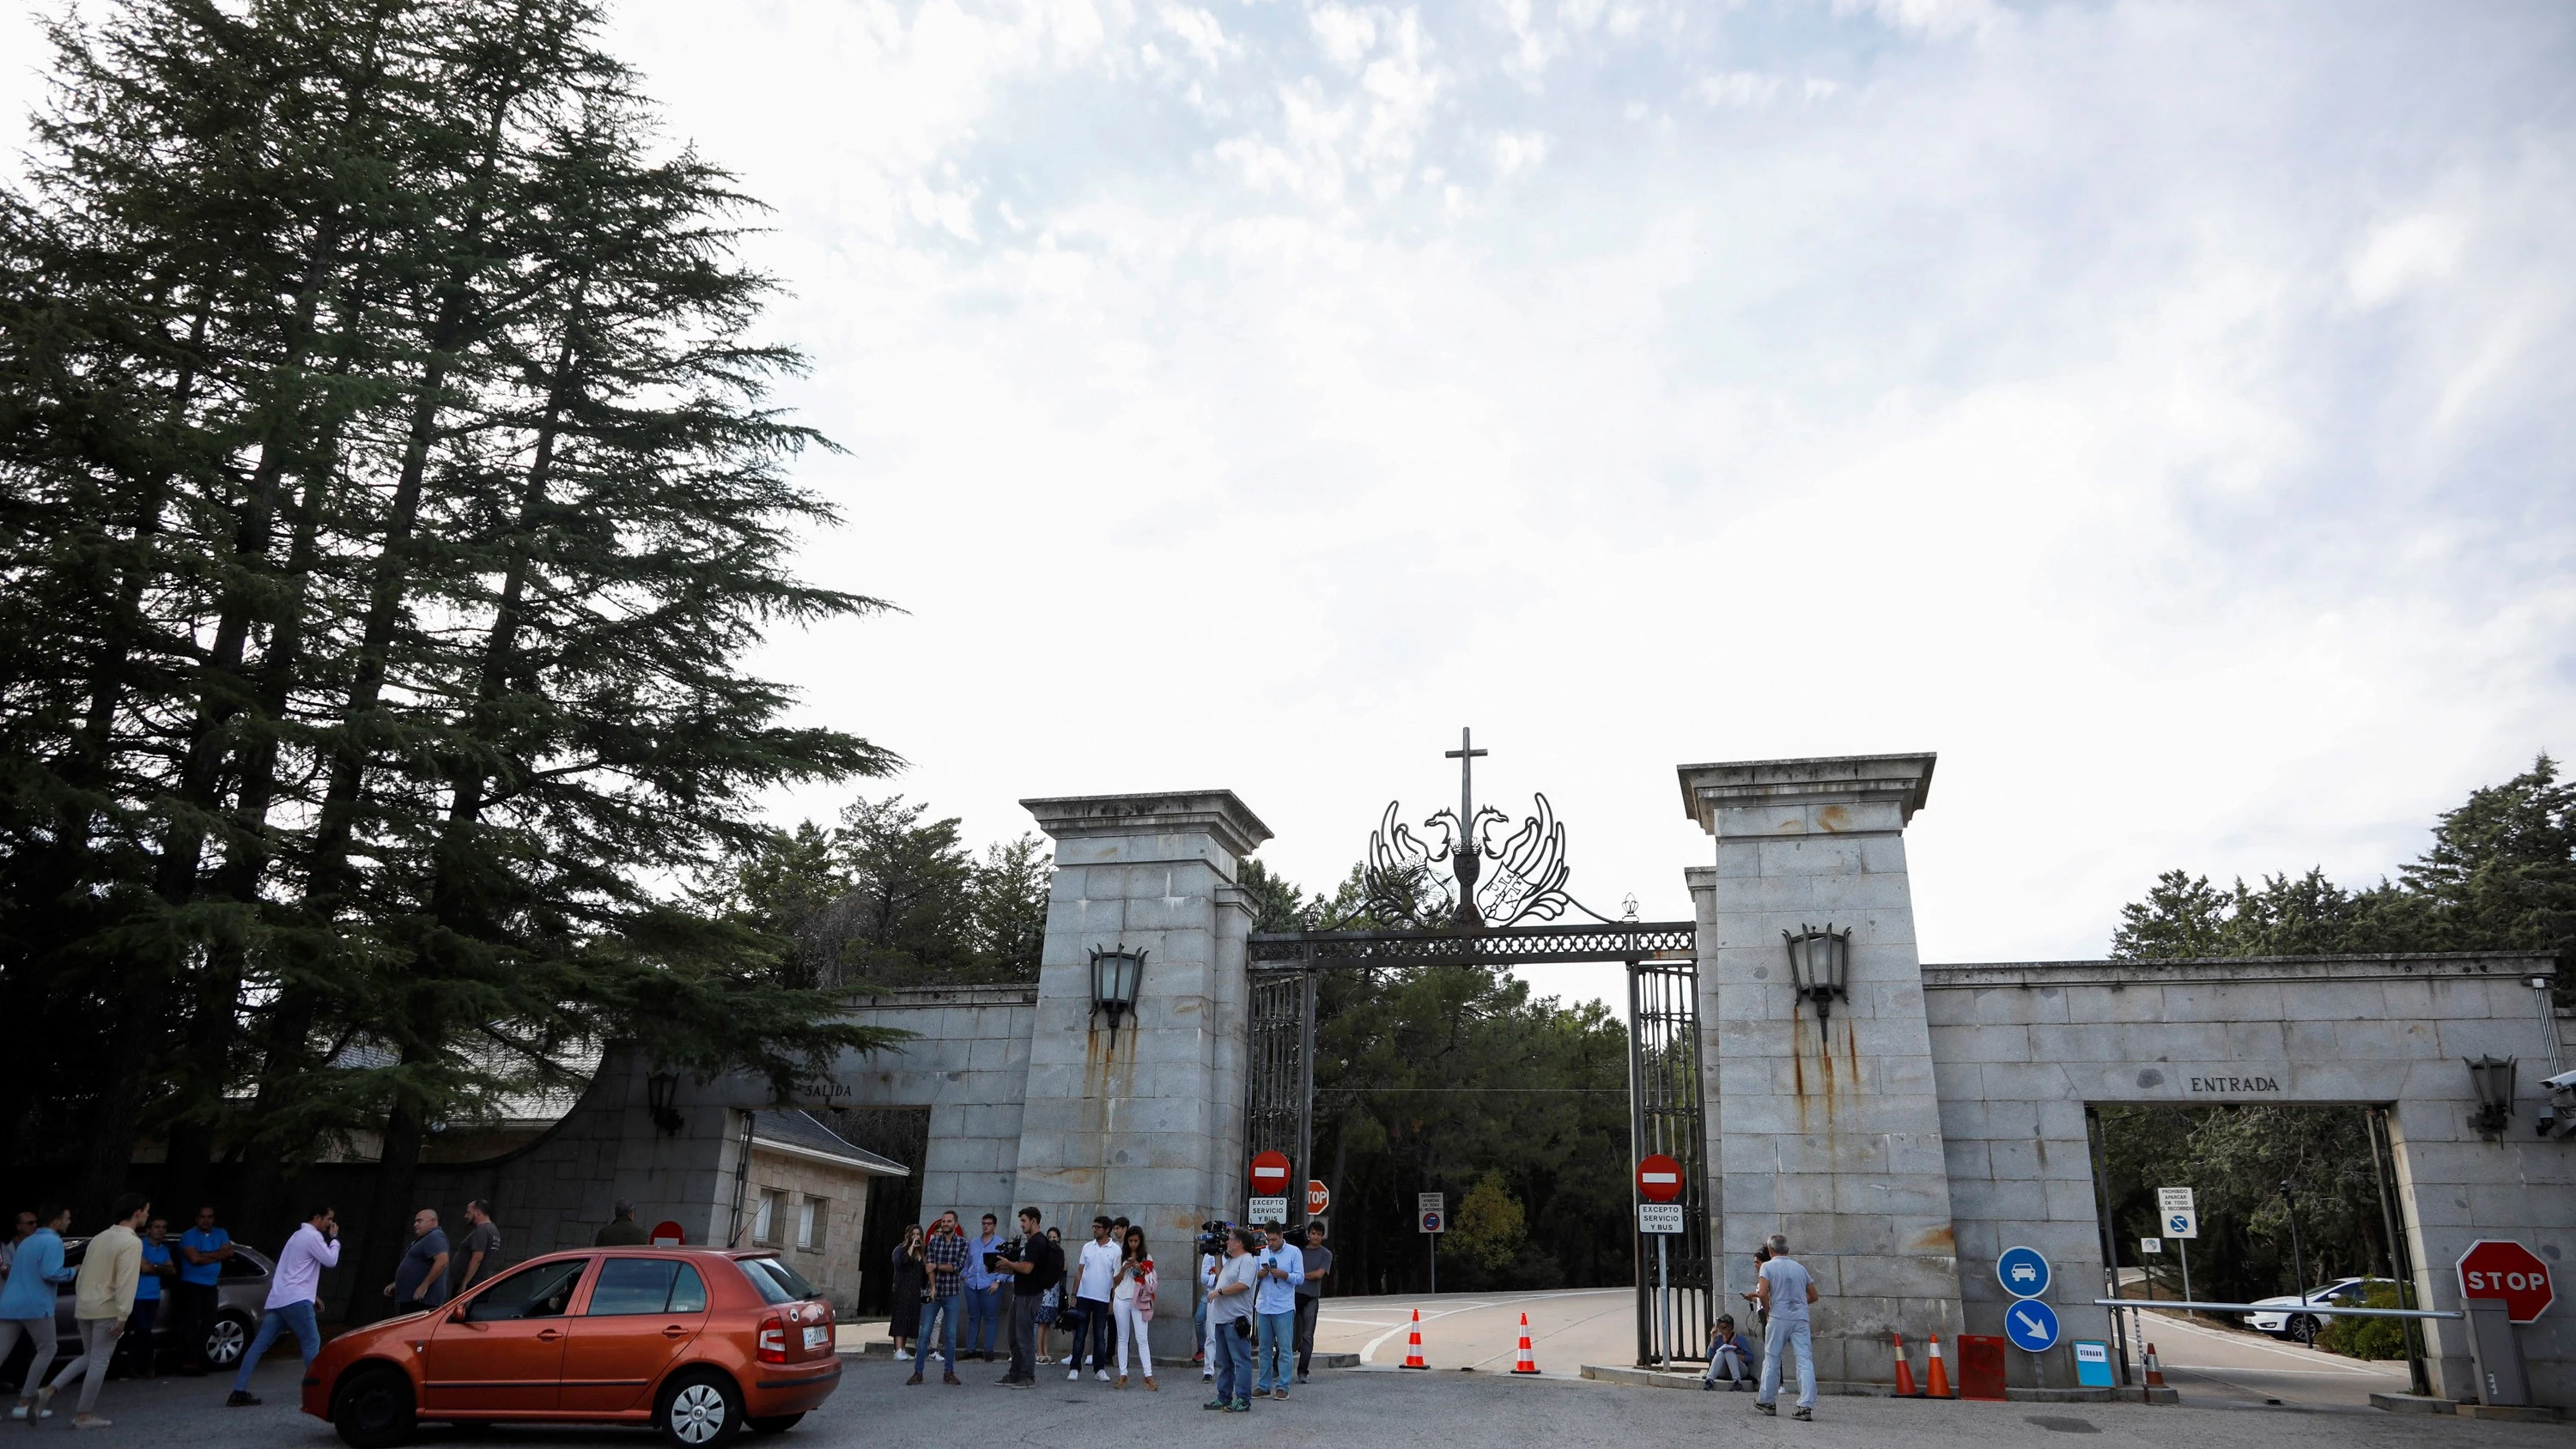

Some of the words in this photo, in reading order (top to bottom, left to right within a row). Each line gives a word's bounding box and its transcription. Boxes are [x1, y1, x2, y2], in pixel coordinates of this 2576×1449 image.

[805, 1084, 852, 1097] SALIDA
[2190, 1077, 2280, 1092] ENTRADA
[1308, 1191, 1327, 1204] TOP
[2468, 1271, 2545, 1291] STOP
